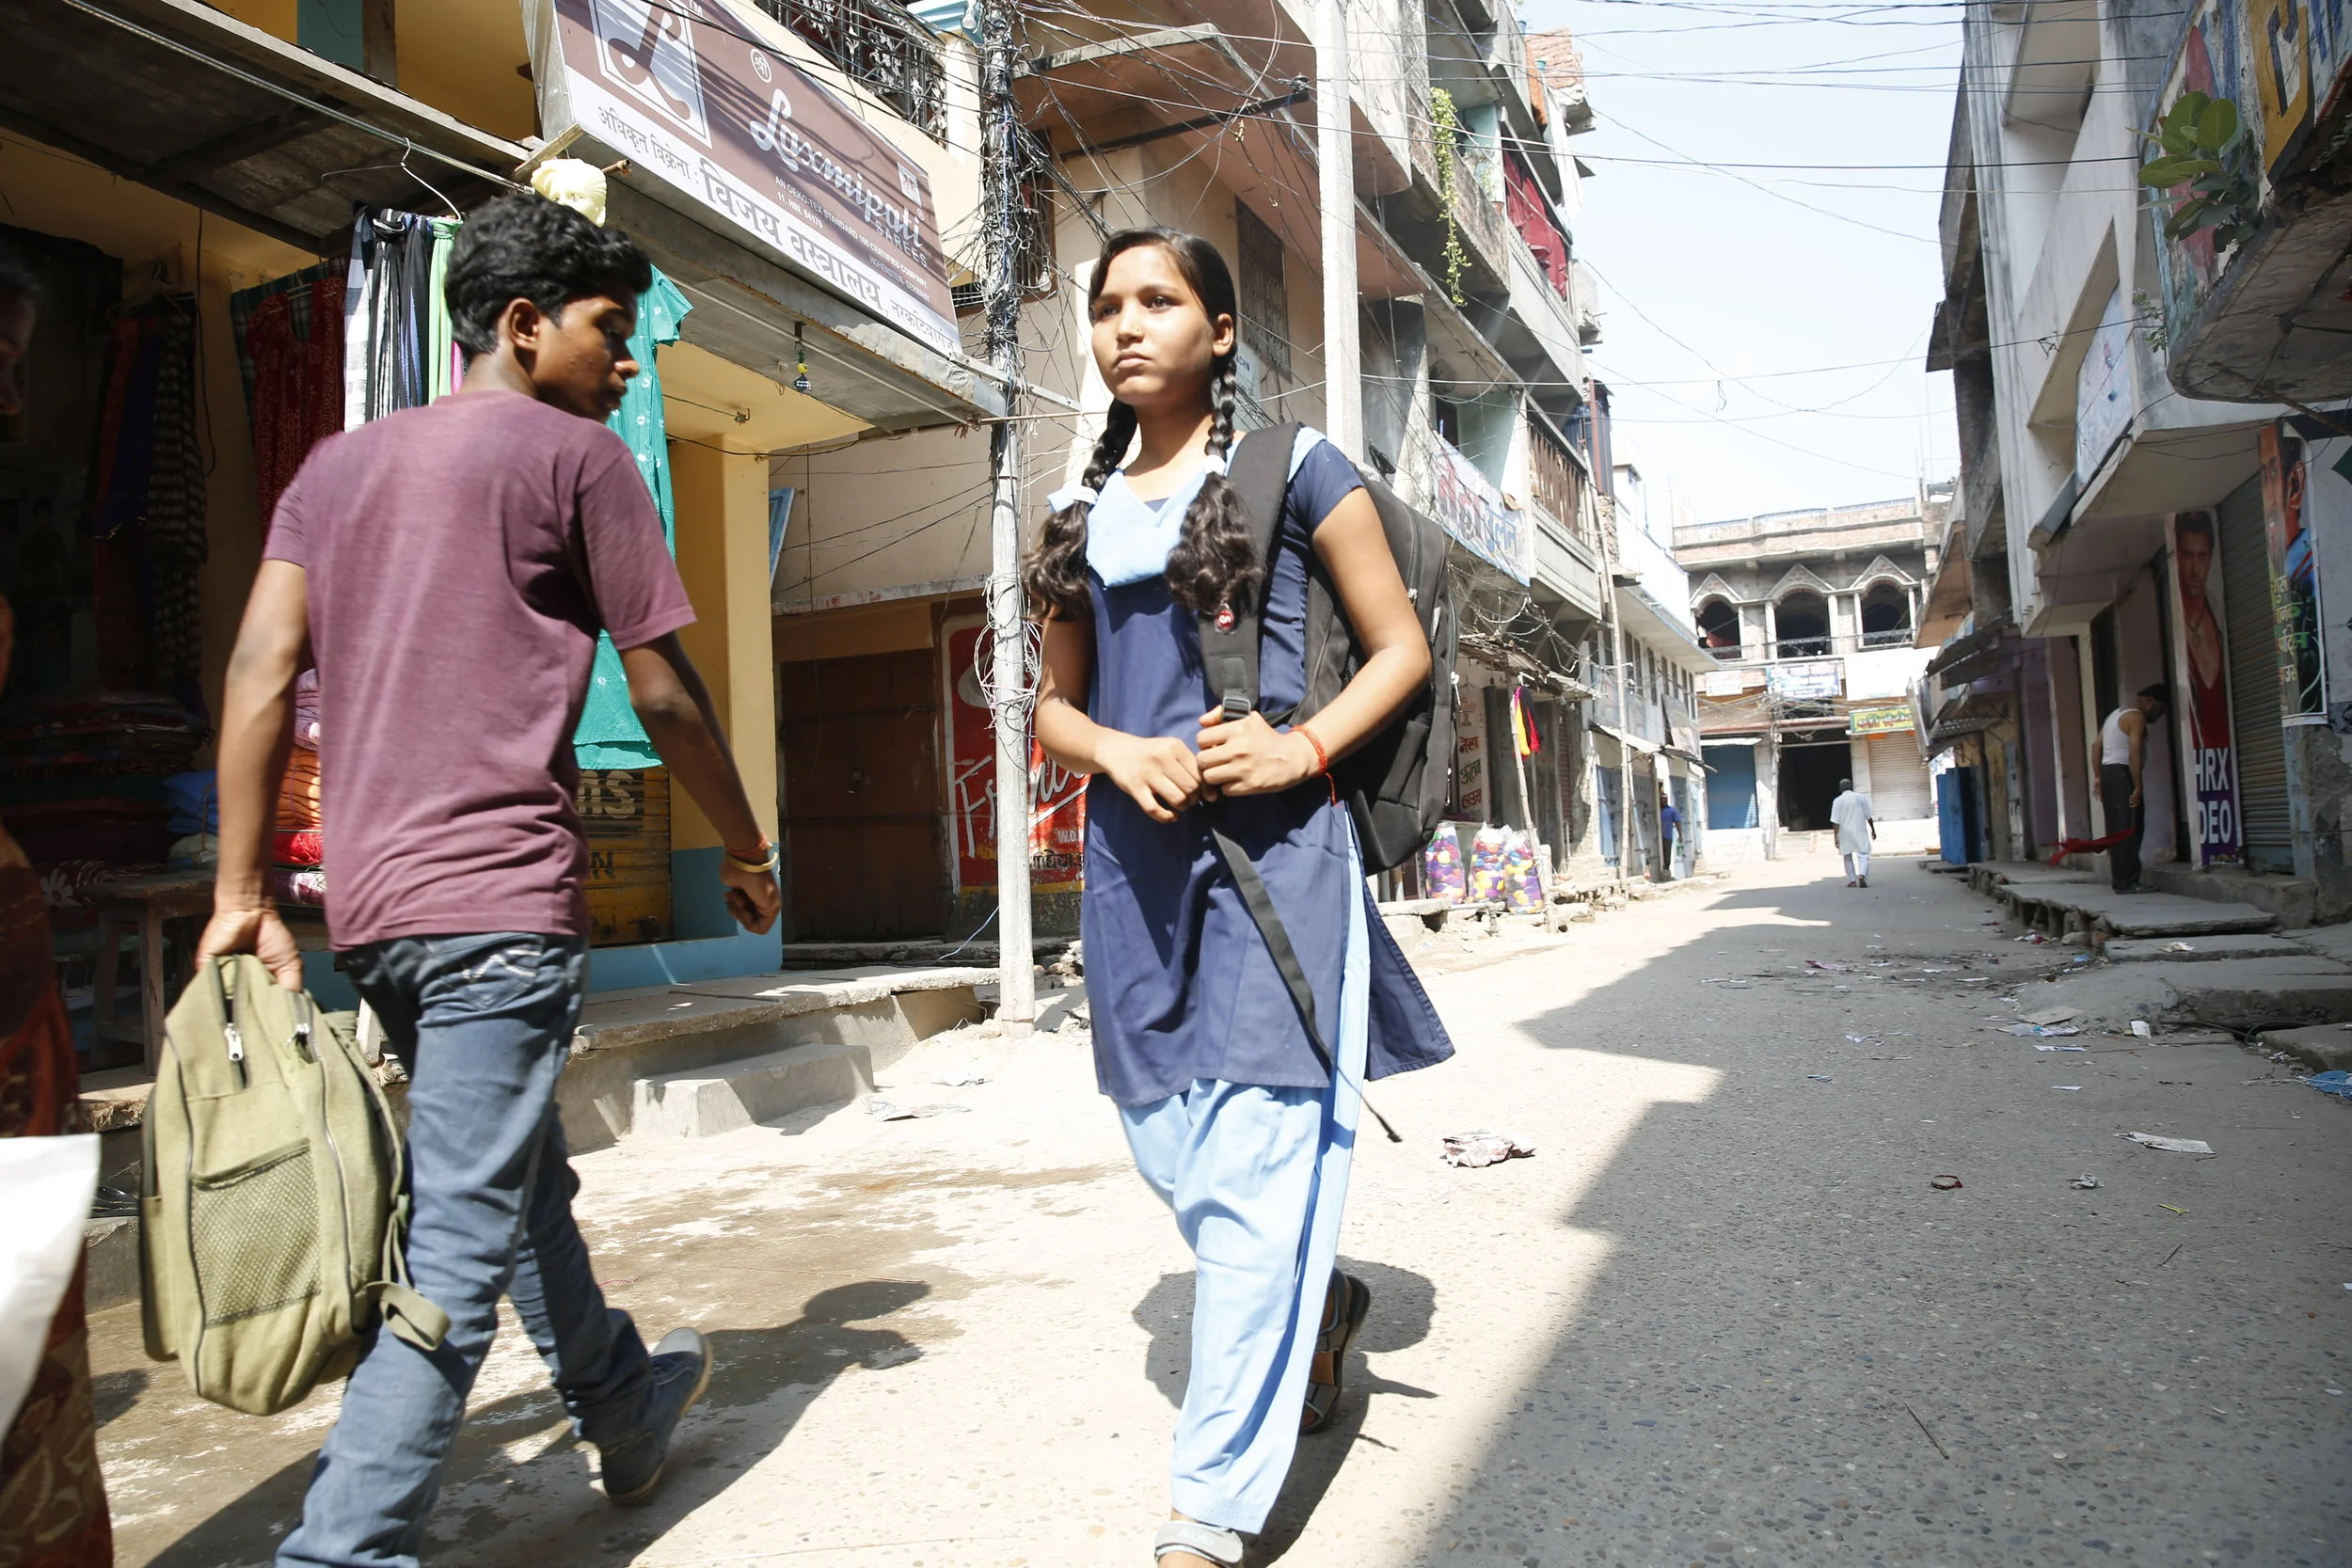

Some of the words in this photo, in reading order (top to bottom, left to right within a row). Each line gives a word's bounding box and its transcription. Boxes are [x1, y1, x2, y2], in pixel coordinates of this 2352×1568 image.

[597, 106, 649, 153] अधिकृत
[699, 157, 783, 247] विजय
[750, 88, 923, 247] Laxmipati
[775, 176, 787, 190] AN
[787, 183, 823, 215] OEKO-TEX
[823, 209, 859, 240] STANDARD
[869, 242, 900, 269] CERTIFIED
[875, 220, 929, 269] SAREES
[2194, 747, 2229, 792] HRX
